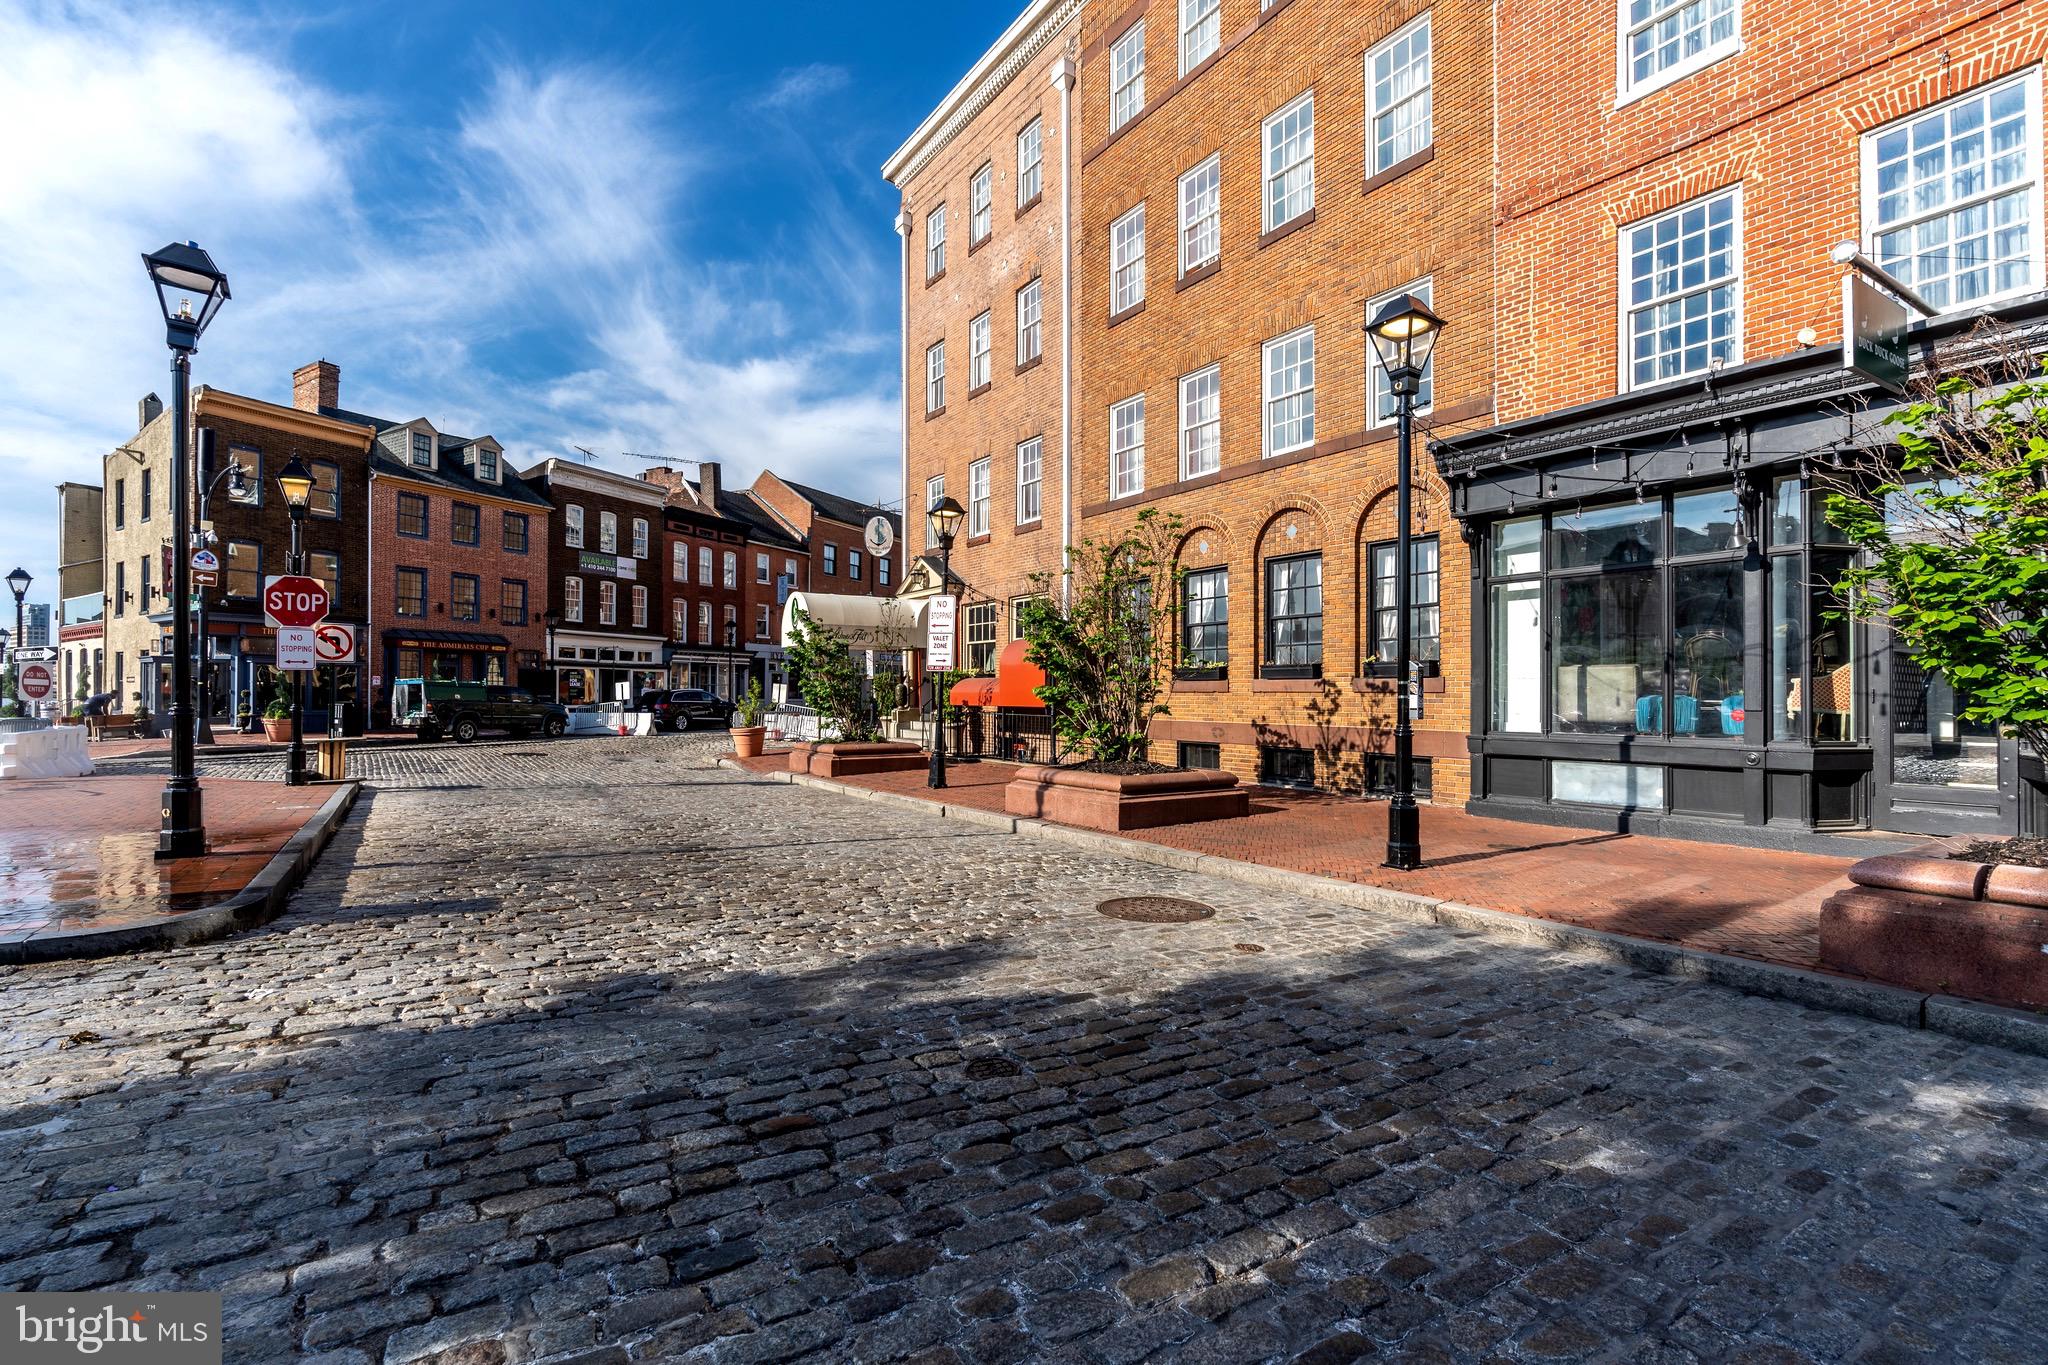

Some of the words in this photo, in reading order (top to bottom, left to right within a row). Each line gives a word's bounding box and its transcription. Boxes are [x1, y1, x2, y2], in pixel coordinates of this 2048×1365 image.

[1858, 336, 1873, 352] DUCK
[1874, 344, 1889, 361] DUCK
[1889, 352, 1905, 369] GOOSE
[581, 555, 617, 568] AVAILABLE
[269, 591, 325, 612] STOP
[936, 600, 948, 608] NO
[930, 611, 953, 620] STOPPING
[290, 634, 303, 642] NO
[280, 645, 313, 653] STOPPING
[438, 642, 474, 650] ADMIRALS
